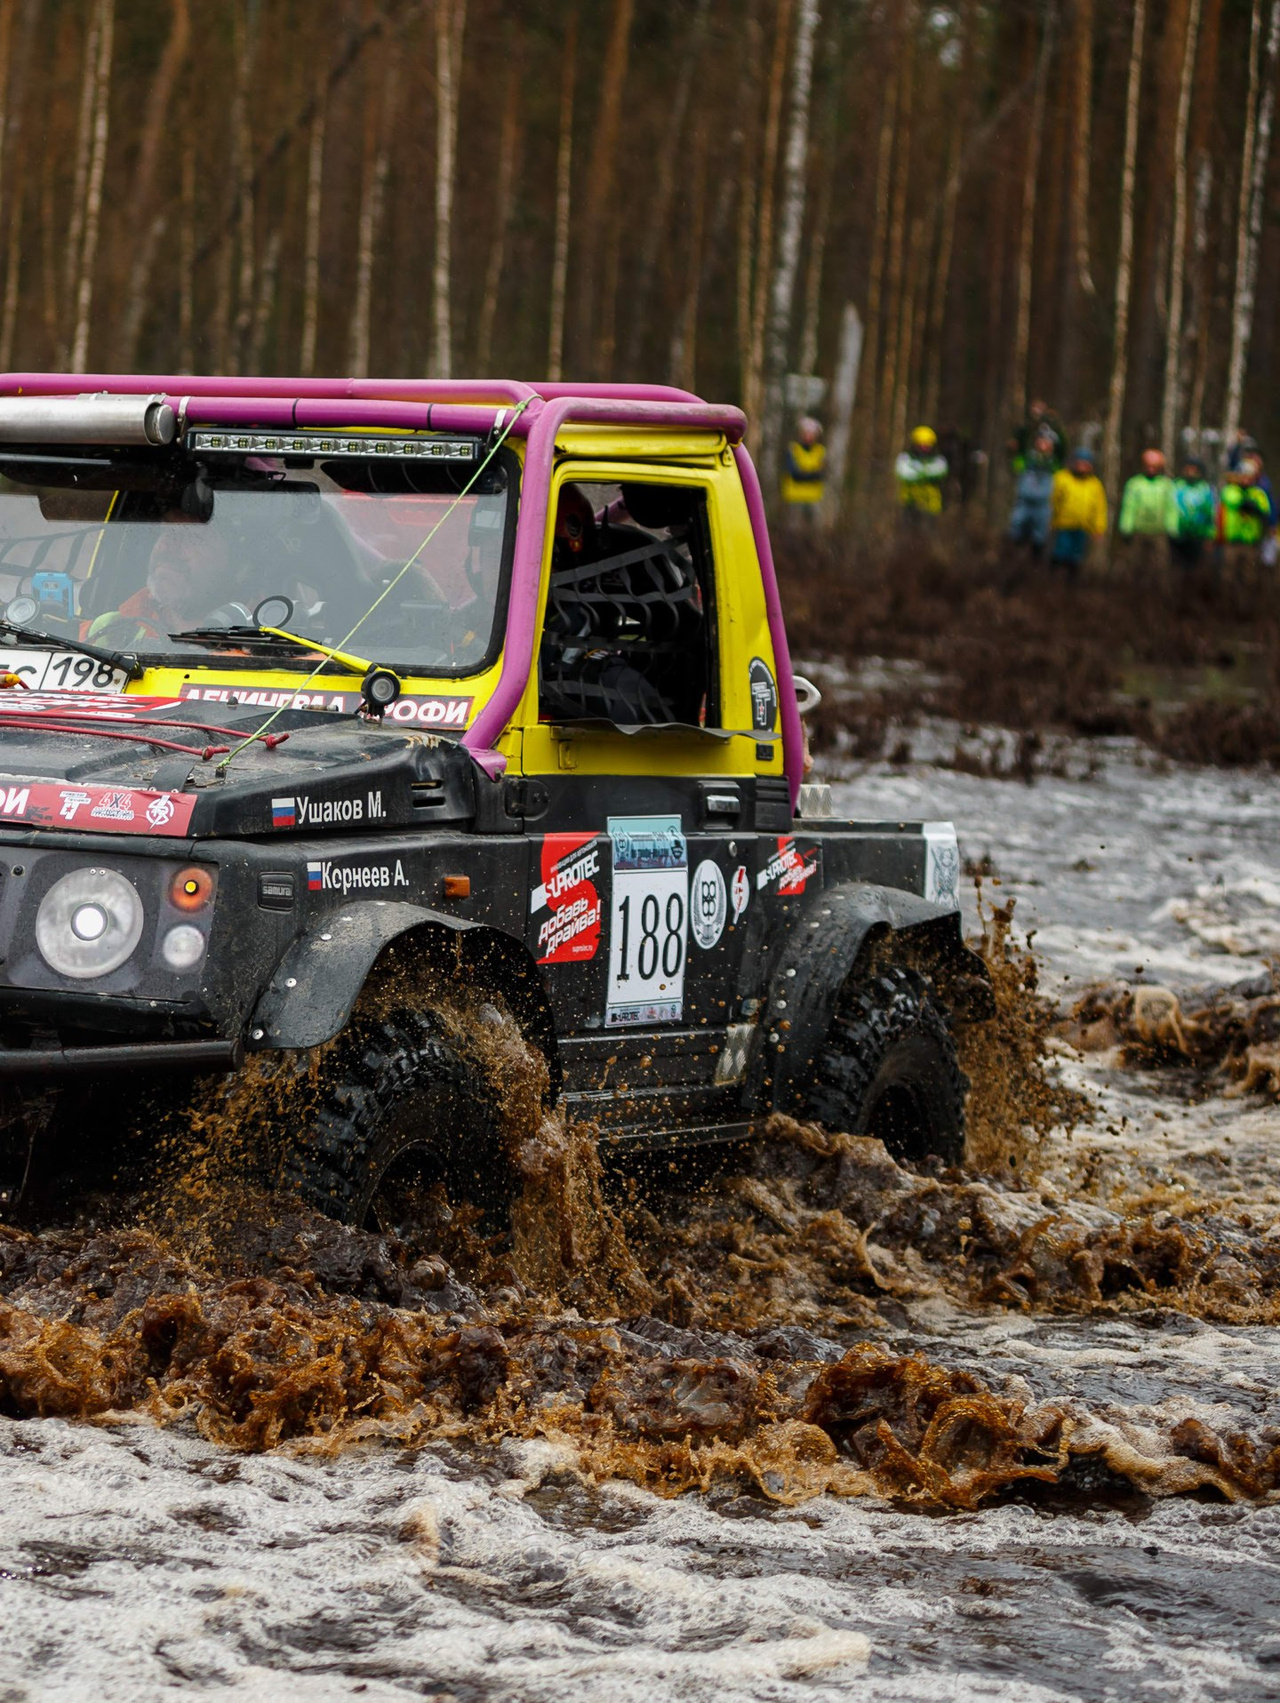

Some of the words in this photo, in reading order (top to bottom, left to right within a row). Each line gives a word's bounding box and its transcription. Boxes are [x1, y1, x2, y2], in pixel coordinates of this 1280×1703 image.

[52, 656, 114, 688] 198
[361, 696, 469, 725] РОФИ
[296, 796, 363, 824] Ушаков
[368, 791, 387, 818] М.
[321, 861, 390, 895] Корнеев
[394, 859, 410, 886] А.
[540, 849, 600, 901] SUPROTEC
[616, 892, 684, 981] 188
